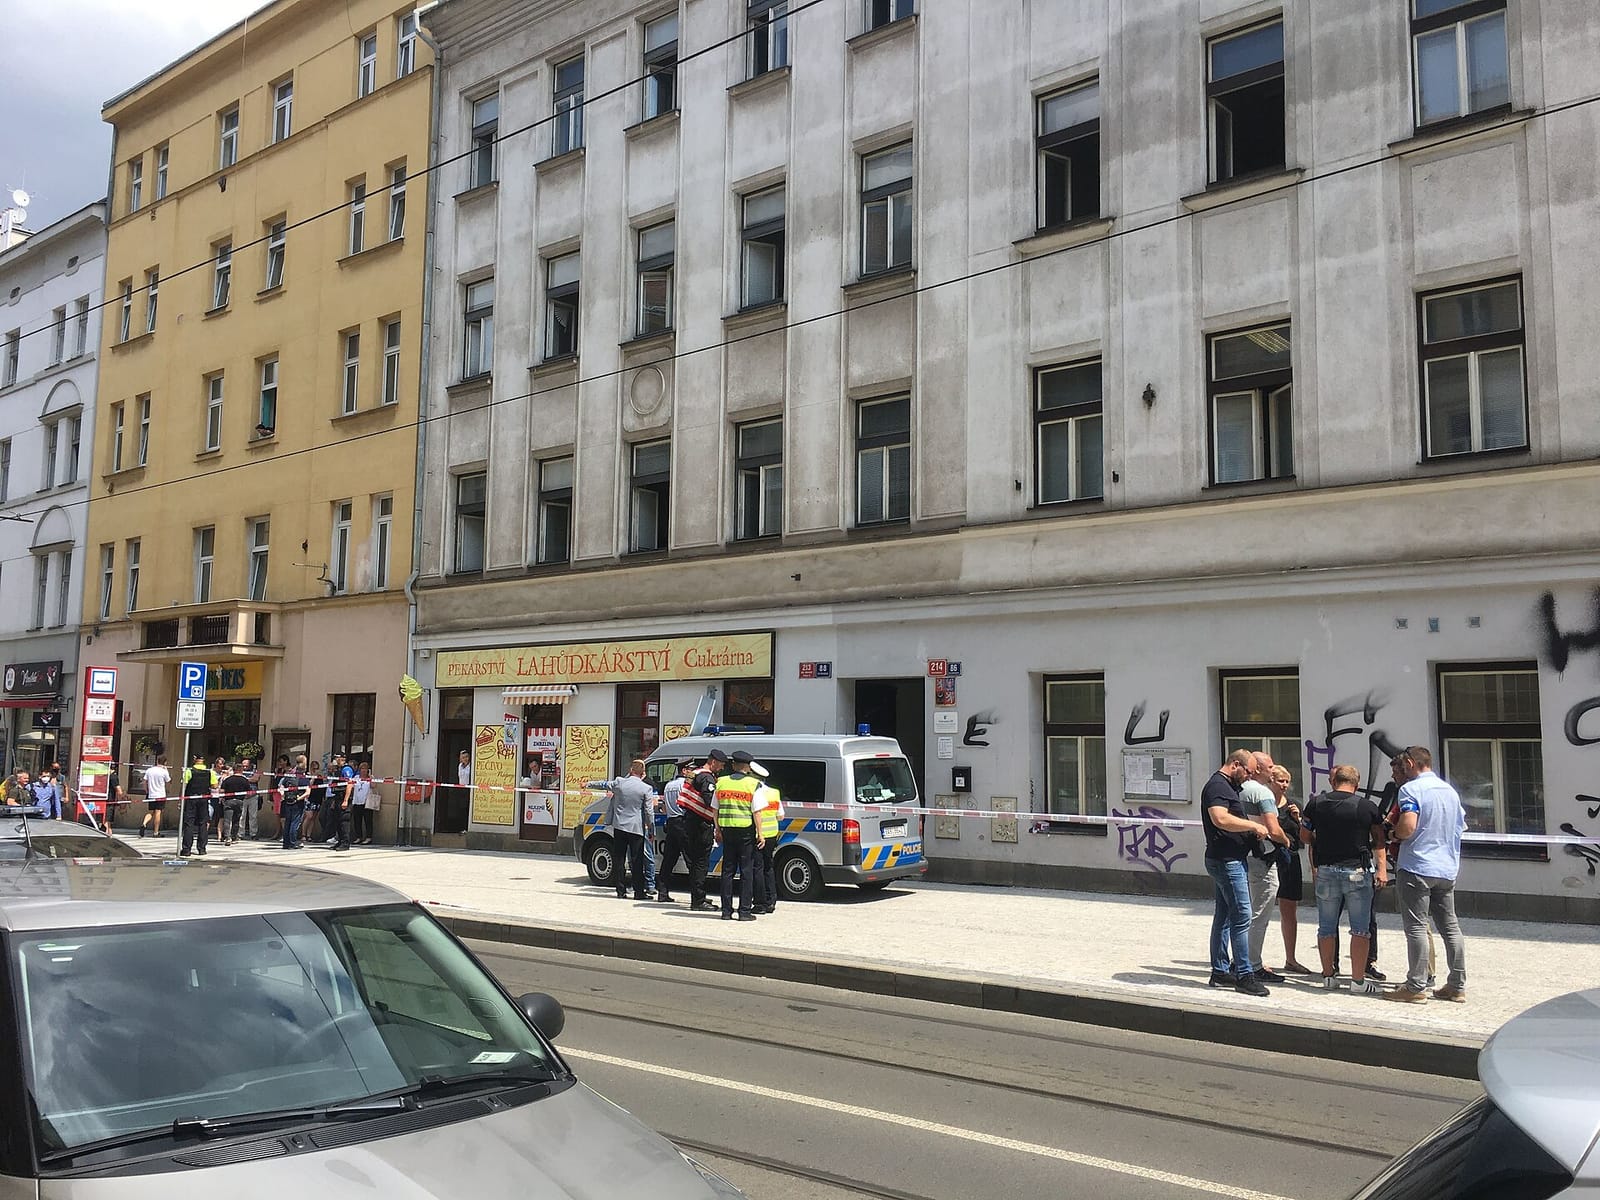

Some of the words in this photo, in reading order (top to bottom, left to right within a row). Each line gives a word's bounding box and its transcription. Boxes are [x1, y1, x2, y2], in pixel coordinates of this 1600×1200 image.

[448, 657, 506, 677] PEKAŘSTVÍ
[516, 643, 671, 676] LAHŮDKÁŘSTVÍ
[683, 646, 754, 668] Cukrárna
[930, 662, 943, 671] 214
[185, 666, 202, 689] P
[823, 821, 837, 831] 158
